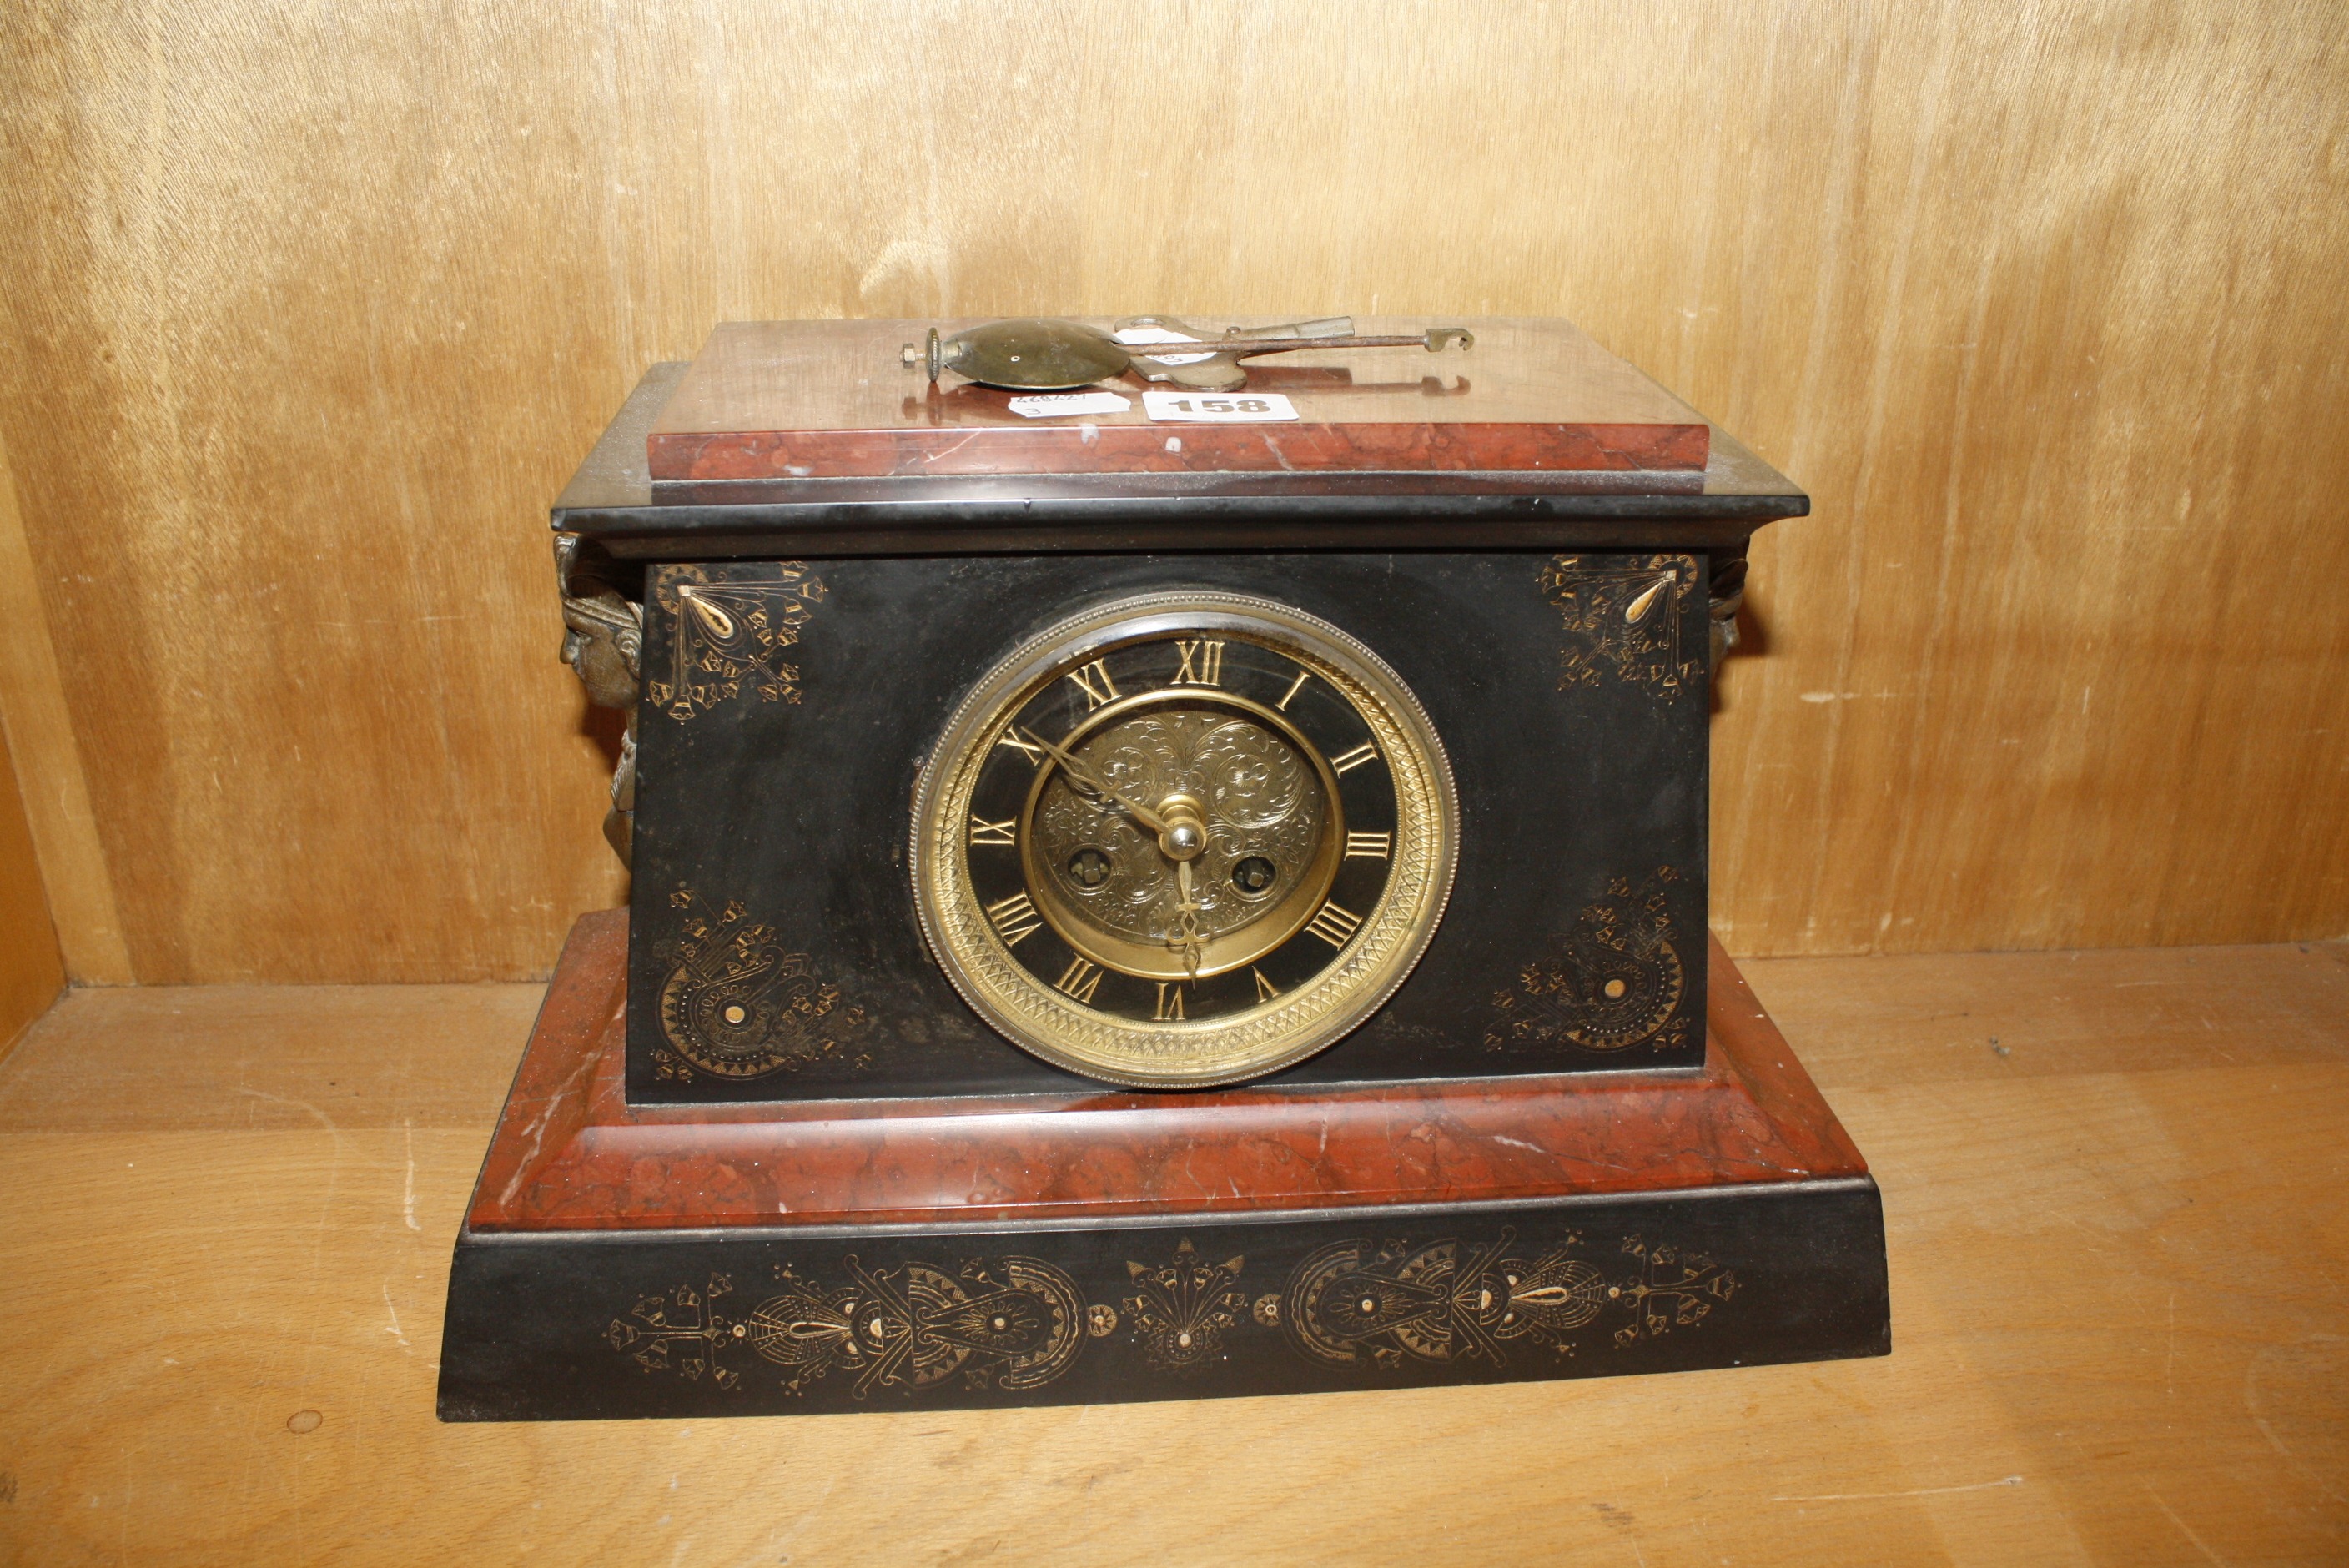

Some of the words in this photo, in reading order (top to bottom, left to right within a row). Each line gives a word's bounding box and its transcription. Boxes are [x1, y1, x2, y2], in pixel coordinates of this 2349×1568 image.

[1168, 400, 1271, 413] 158
[1172, 641, 1225, 686] XII
[1067, 657, 1123, 712] XI
[1275, 671, 1311, 711] I
[997, 725, 1047, 766] X
[1330, 740, 1381, 776] II
[970, 814, 1017, 846] IX
[1346, 830, 1391, 860] III
[985, 888, 1044, 947] VIII
[1305, 897, 1364, 950] IIII
[1053, 953, 1104, 1004] VII
[1253, 966, 1283, 1003] V
[1152, 983, 1185, 1020] VI
